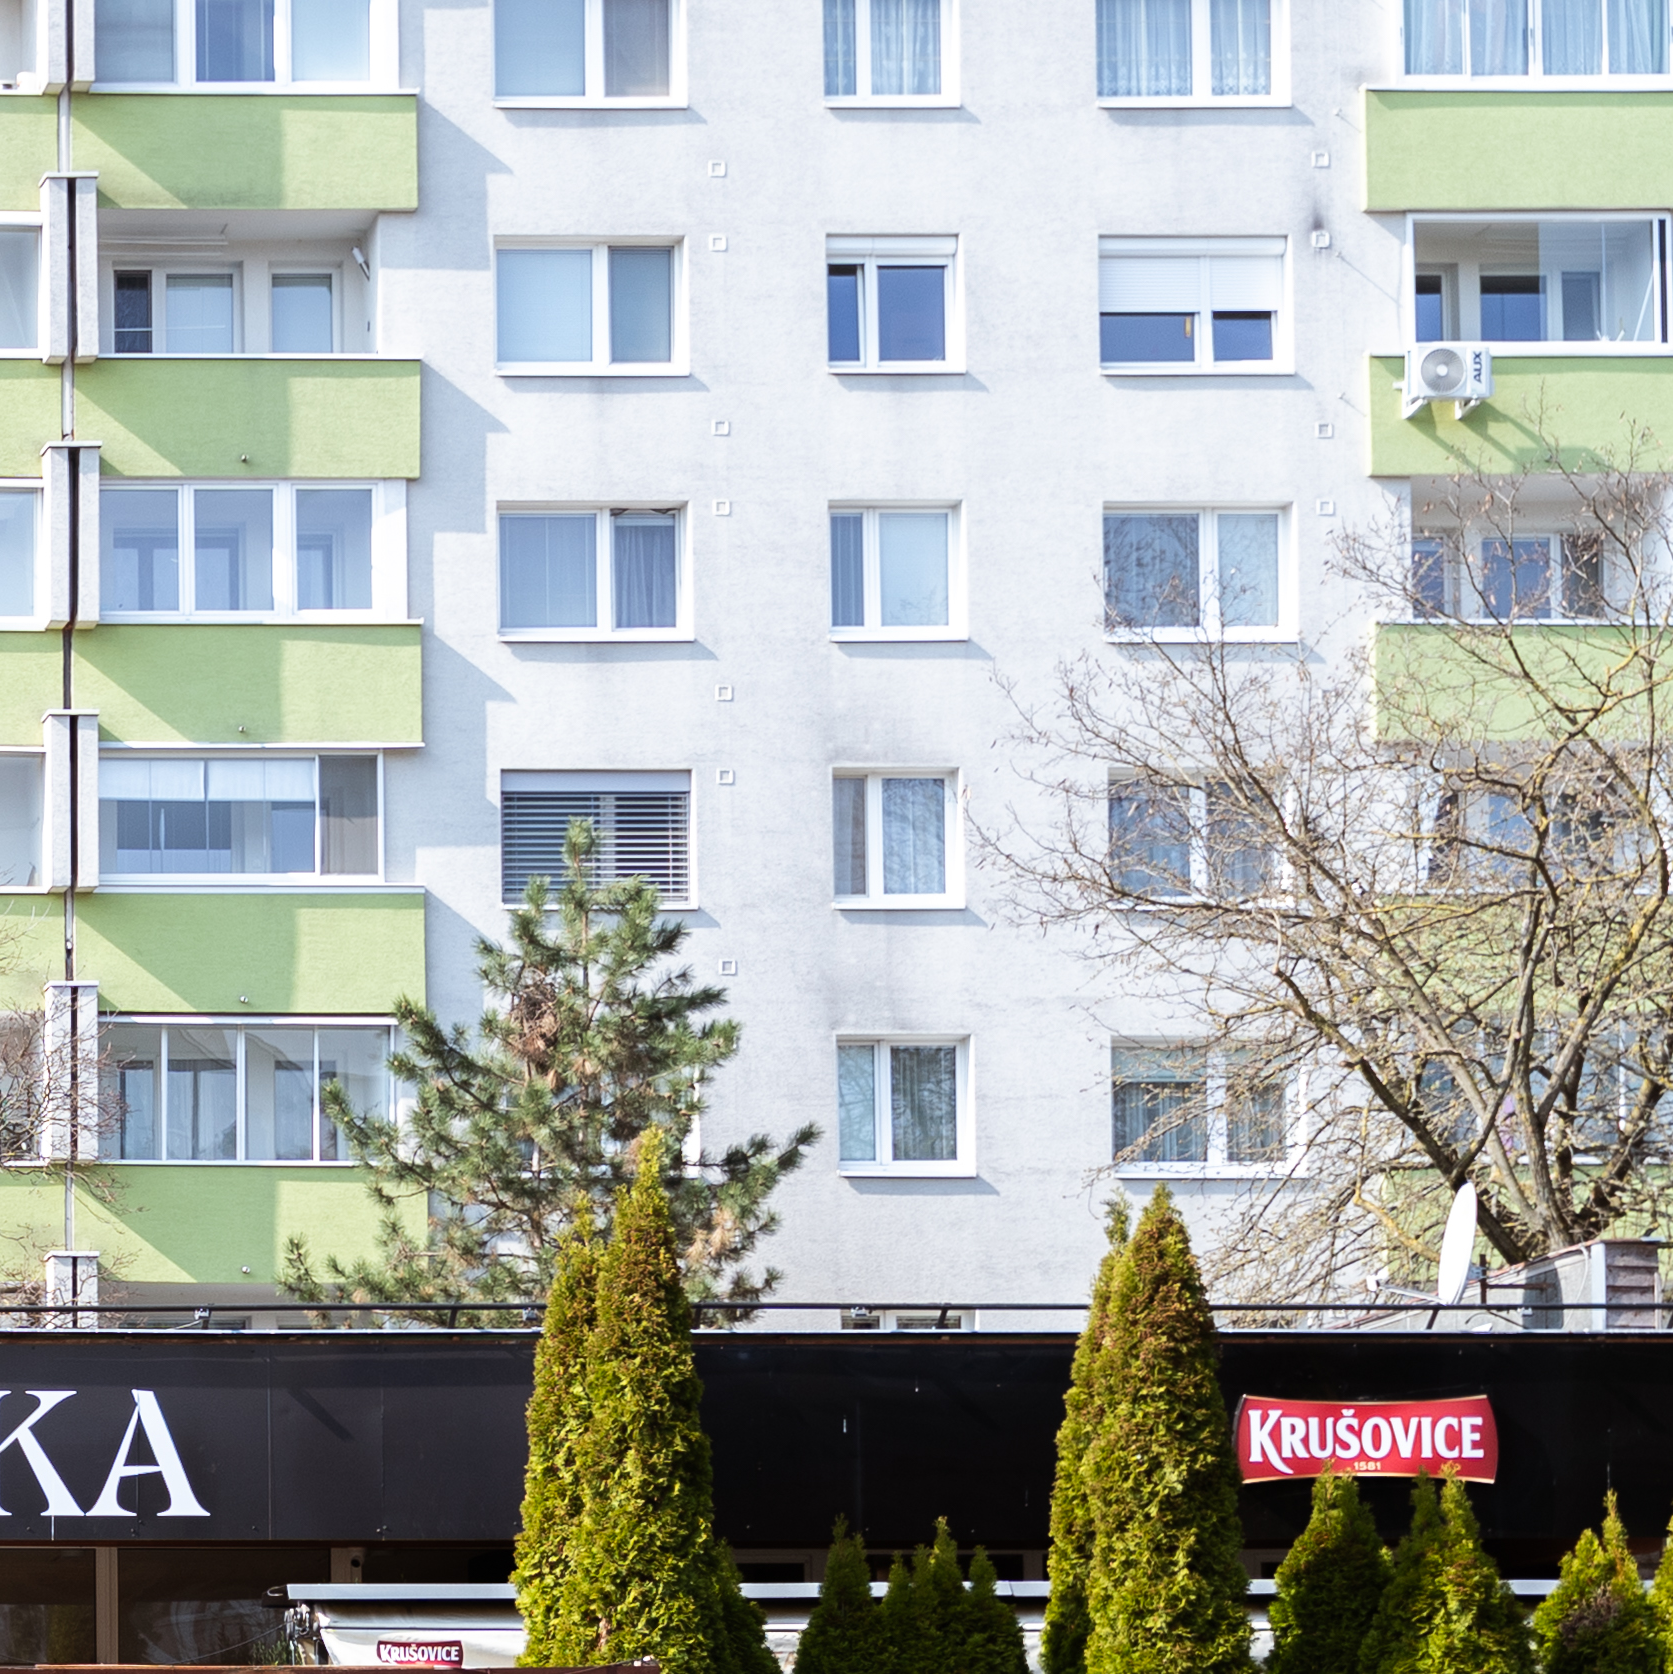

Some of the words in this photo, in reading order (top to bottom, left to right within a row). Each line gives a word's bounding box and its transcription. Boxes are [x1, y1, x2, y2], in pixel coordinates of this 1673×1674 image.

[1473, 351, 1482, 384] AUX
[1248, 1408, 1485, 1474] KRUŠOVICE
[1354, 1461, 1382, 1471] 1581
[379, 1643, 460, 1664] KRUŠOVICE
